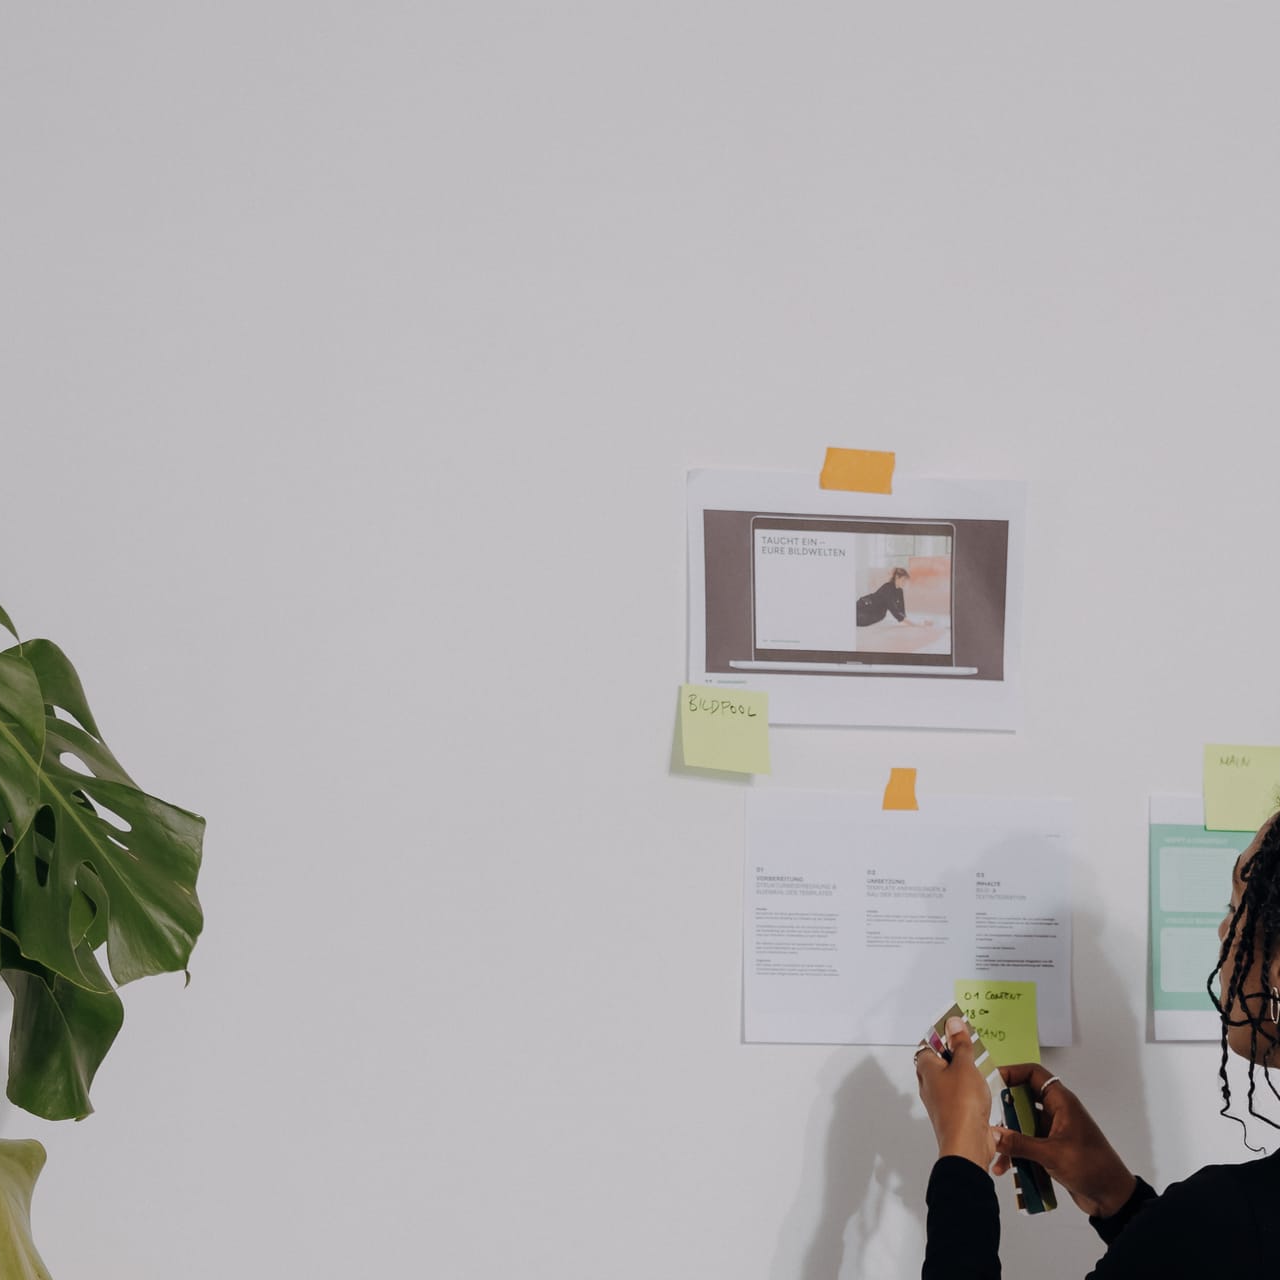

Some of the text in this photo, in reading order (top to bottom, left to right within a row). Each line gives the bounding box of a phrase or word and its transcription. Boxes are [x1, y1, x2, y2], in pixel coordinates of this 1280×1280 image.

[761, 536, 800, 546] TAUCHT
[801, 538, 818, 546] EIN
[761, 546, 846, 557] EURE BILDWELTEN
[688, 694, 757, 718] BILDPOOL
[976, 1027, 1006, 1041] RAND
